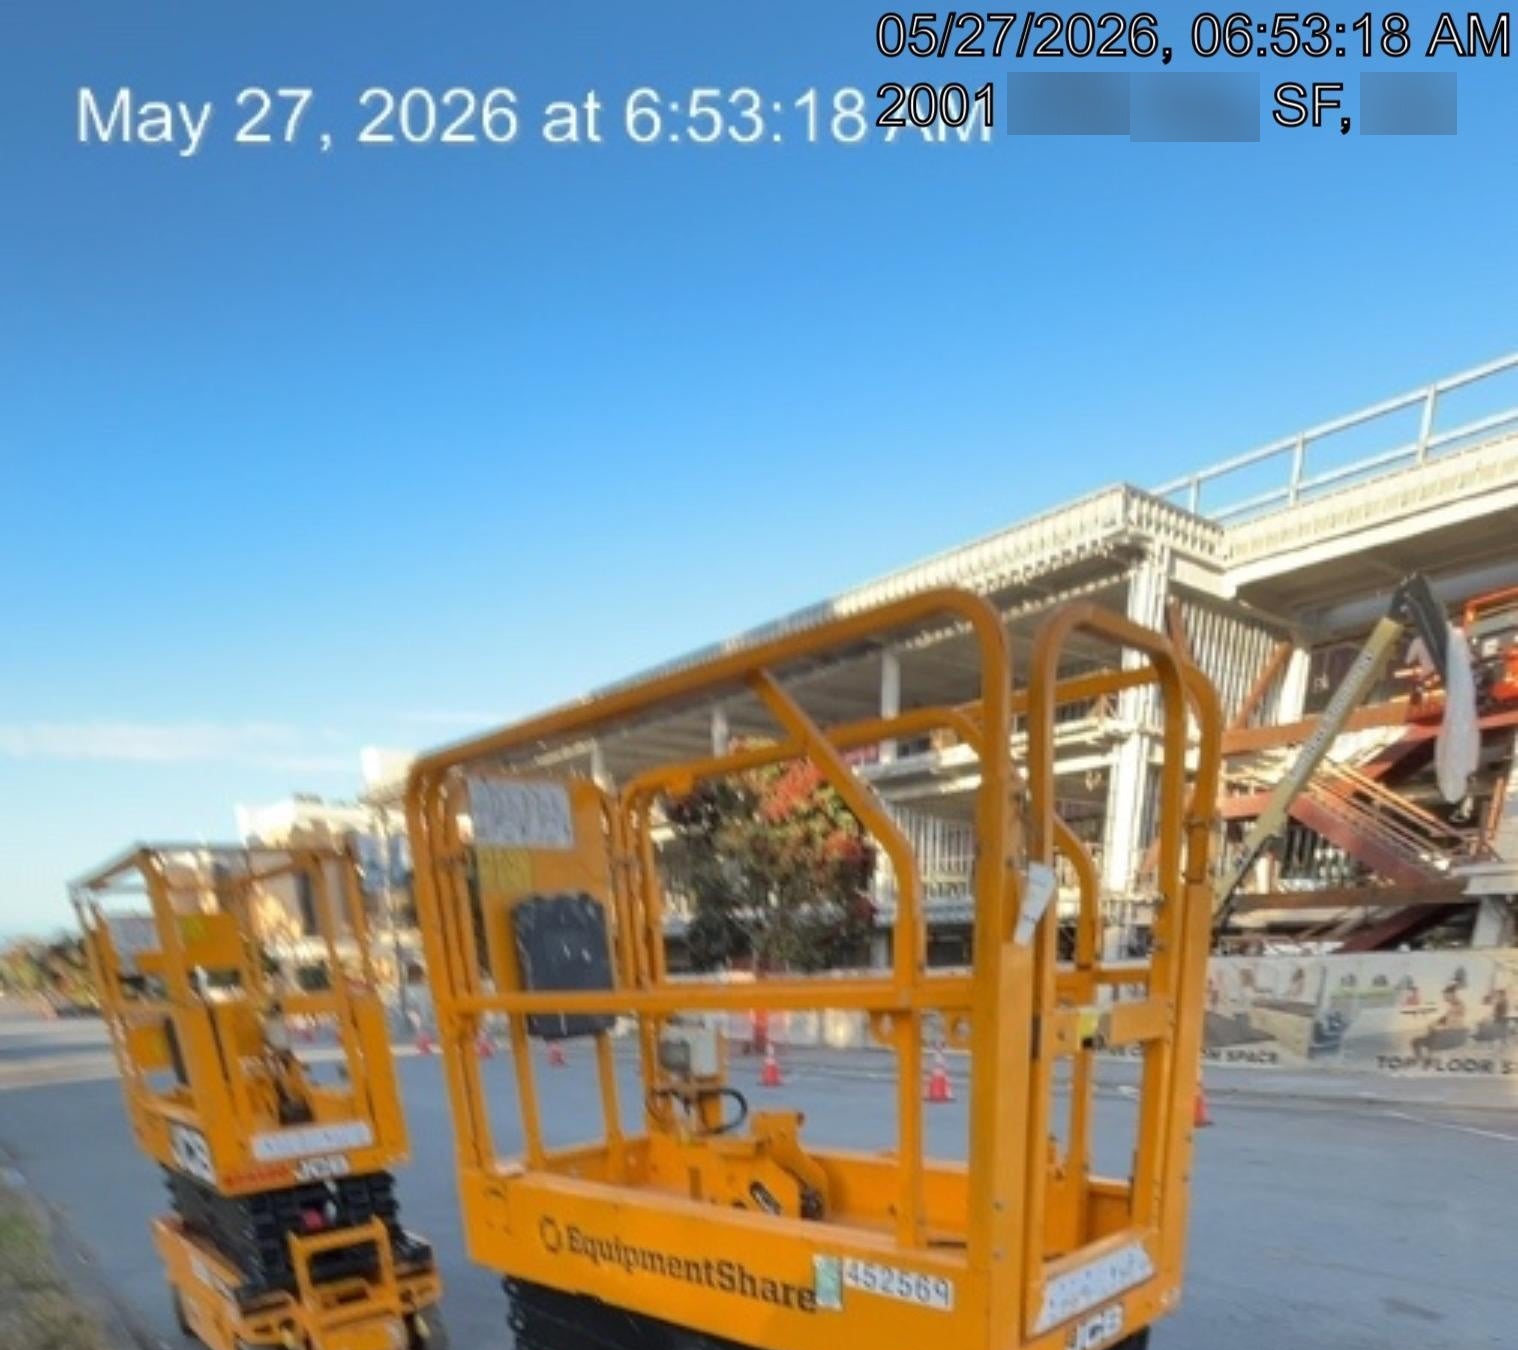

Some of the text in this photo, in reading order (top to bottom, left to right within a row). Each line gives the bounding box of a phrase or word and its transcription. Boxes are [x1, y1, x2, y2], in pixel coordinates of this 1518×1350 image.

[1377, 1055, 1420, 1070] TOP
[1422, 1057, 1494, 1074] FLOOR
[566, 1226, 817, 1314] EquipmentShare
